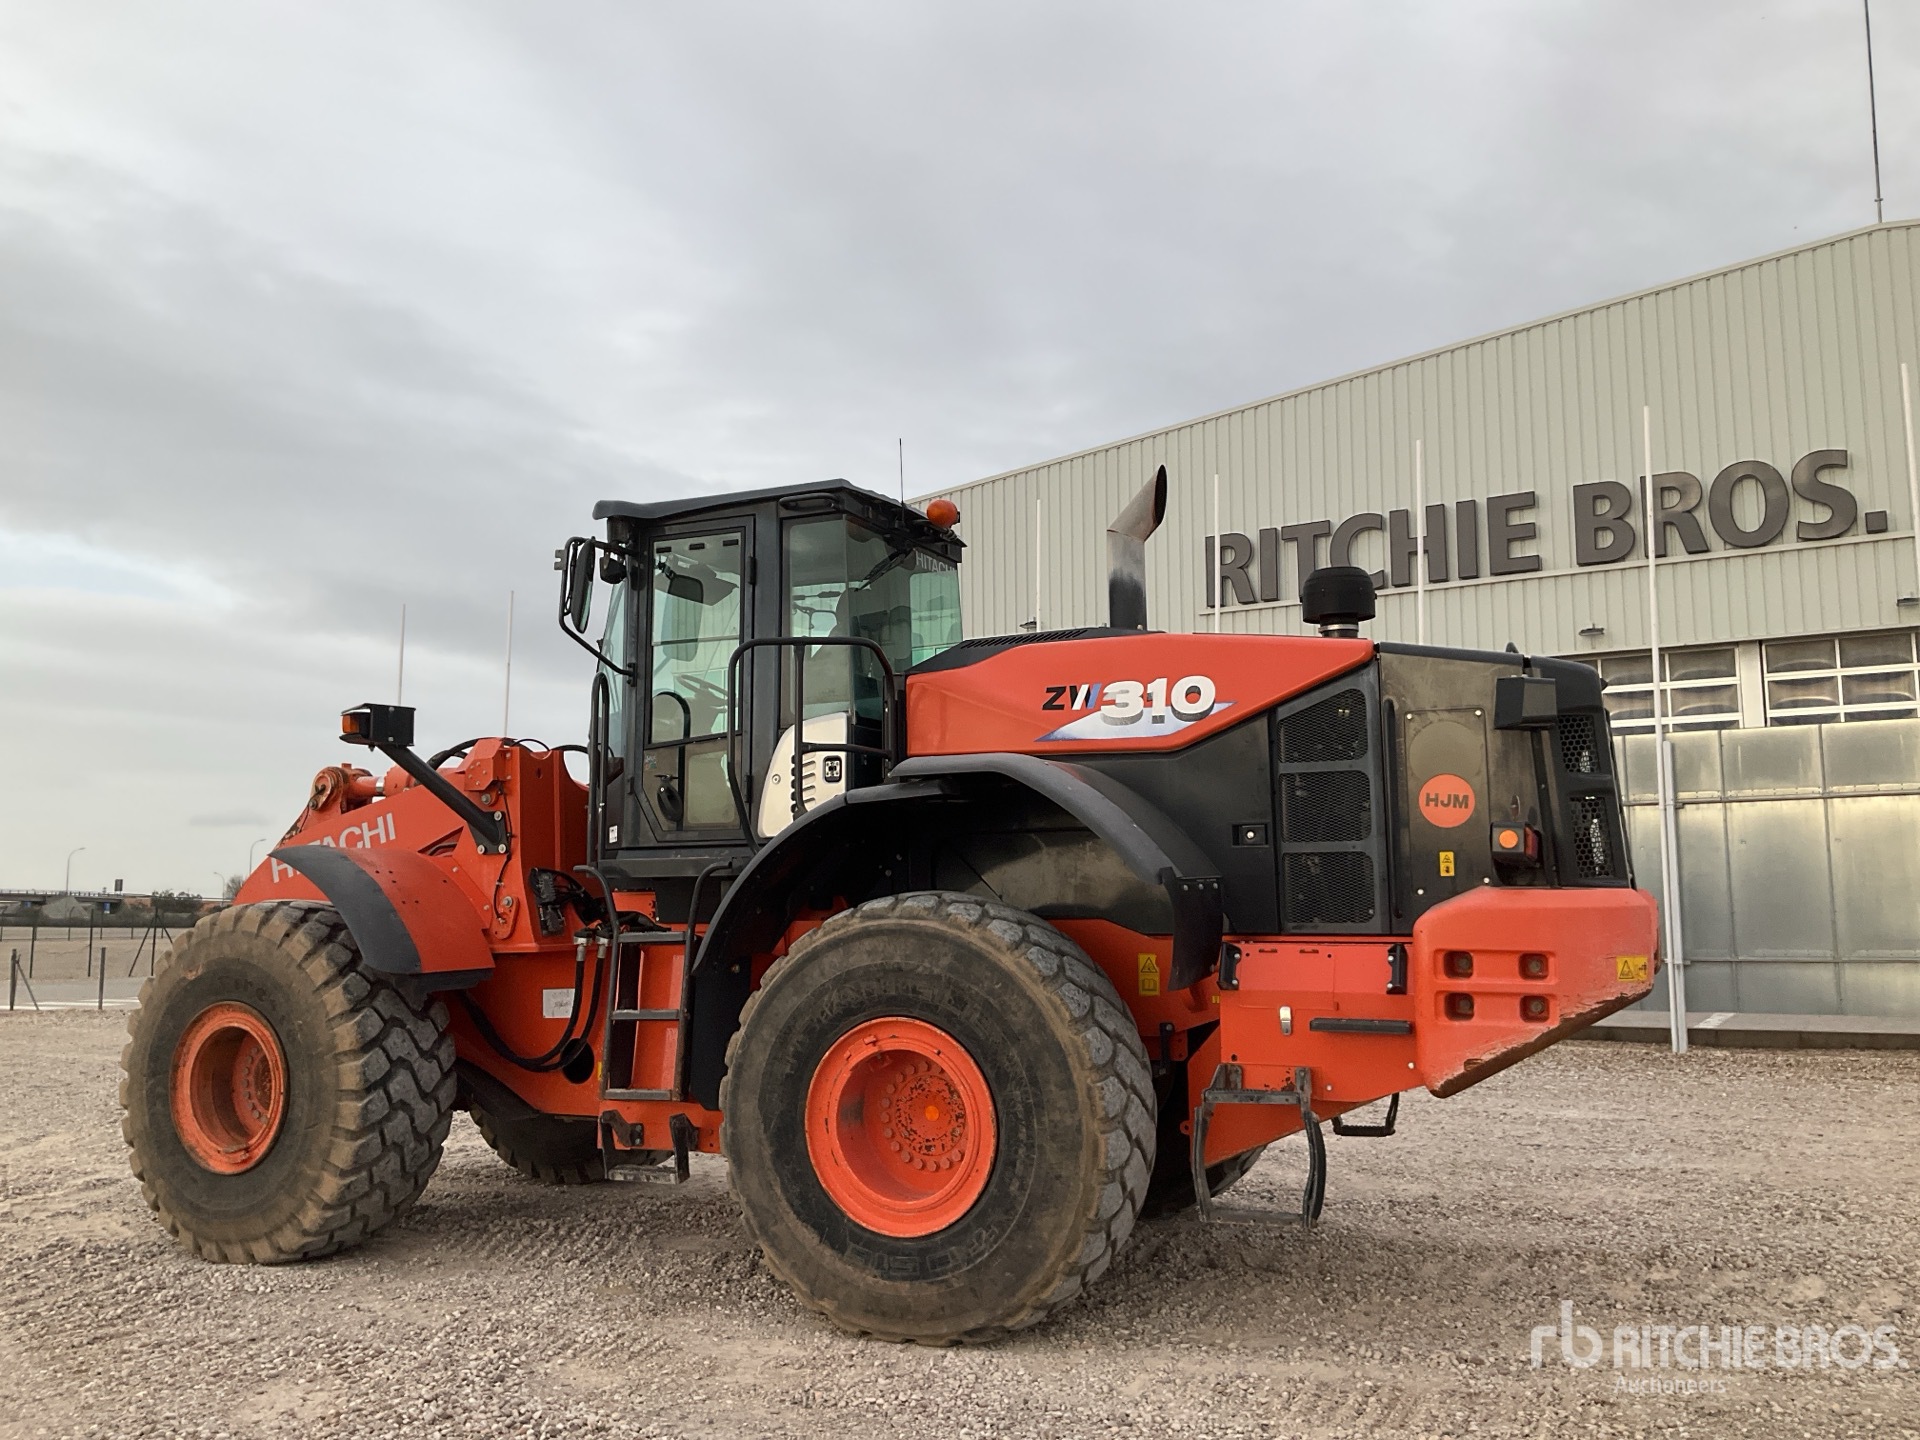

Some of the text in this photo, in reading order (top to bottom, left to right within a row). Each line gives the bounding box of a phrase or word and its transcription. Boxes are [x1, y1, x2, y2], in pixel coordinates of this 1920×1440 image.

[1205, 449, 1888, 609] RITCHIE BROS.
[1425, 793, 1469, 809] HJM
[270, 812, 397, 884] HCHI
